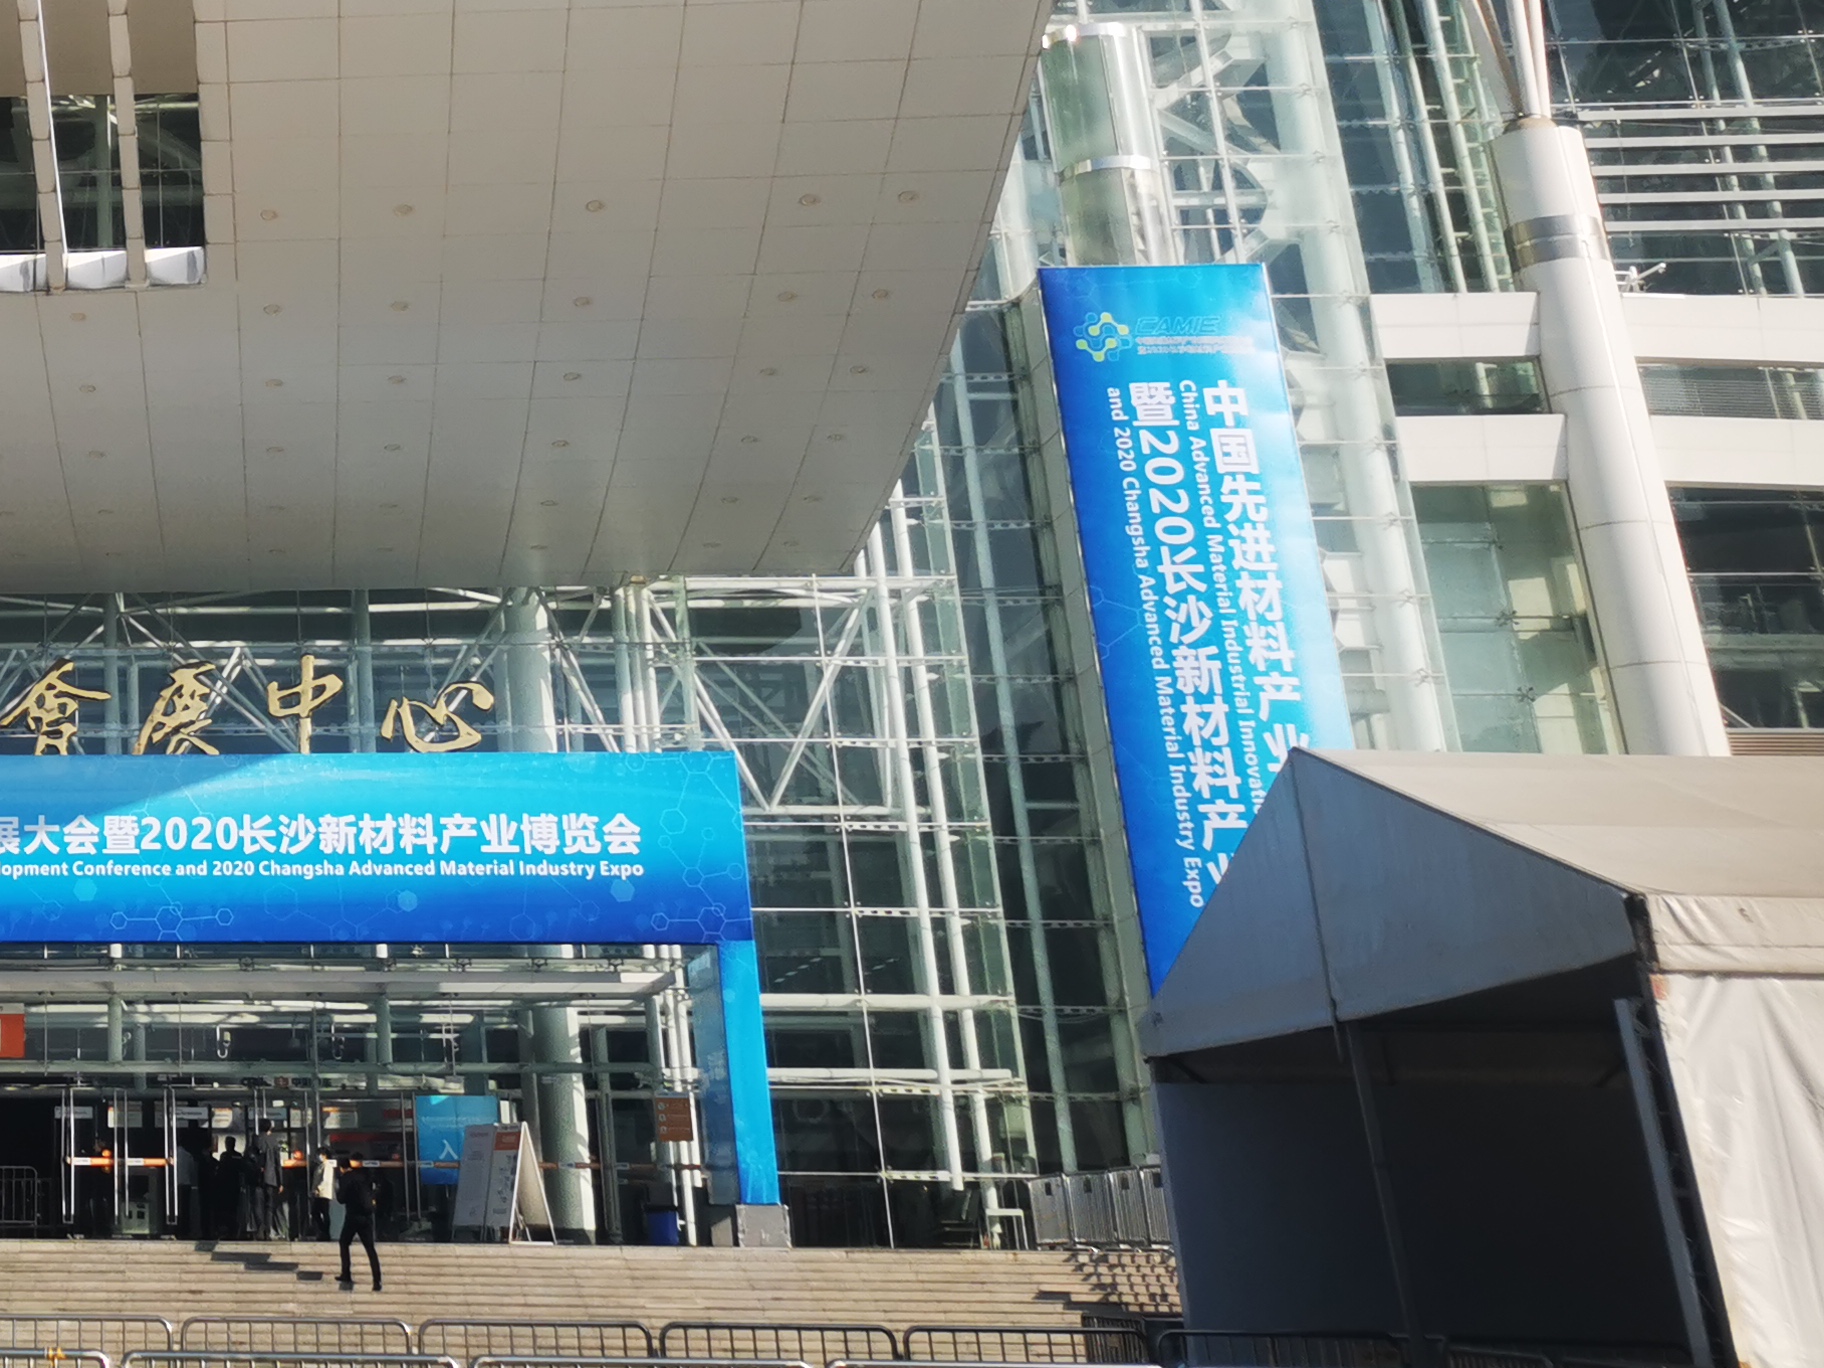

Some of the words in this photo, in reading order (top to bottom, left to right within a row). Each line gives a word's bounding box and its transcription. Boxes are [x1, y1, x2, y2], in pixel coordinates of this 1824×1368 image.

[1135, 316, 1220, 335] CAMIE
[1107, 386, 1129, 422] and
[1179, 380, 1200, 431] China
[1114, 427, 1137, 472] 2020
[1189, 436, 1222, 529] Advanced
[1123, 477, 1151, 569] Changsha
[1206, 534, 1237, 614] Material
[1138, 574, 1170, 670] Advanced
[1221, 620, 1255, 714] Industrial
[1154, 675, 1185, 759] Material
[1169, 764, 1196, 851] Industry
[72, 860, 171, 876] Conference
[175, 860, 208, 876] and
[212, 861, 255, 876] 2020
[259, 859, 345, 880] Changsha
[349, 859, 436, 876] Advanced
[440, 859, 515, 876] Material
[519, 859, 596, 880] Industry
[600, 860, 645, 880] Expo
[1182, 857, 1204, 909] Expo
